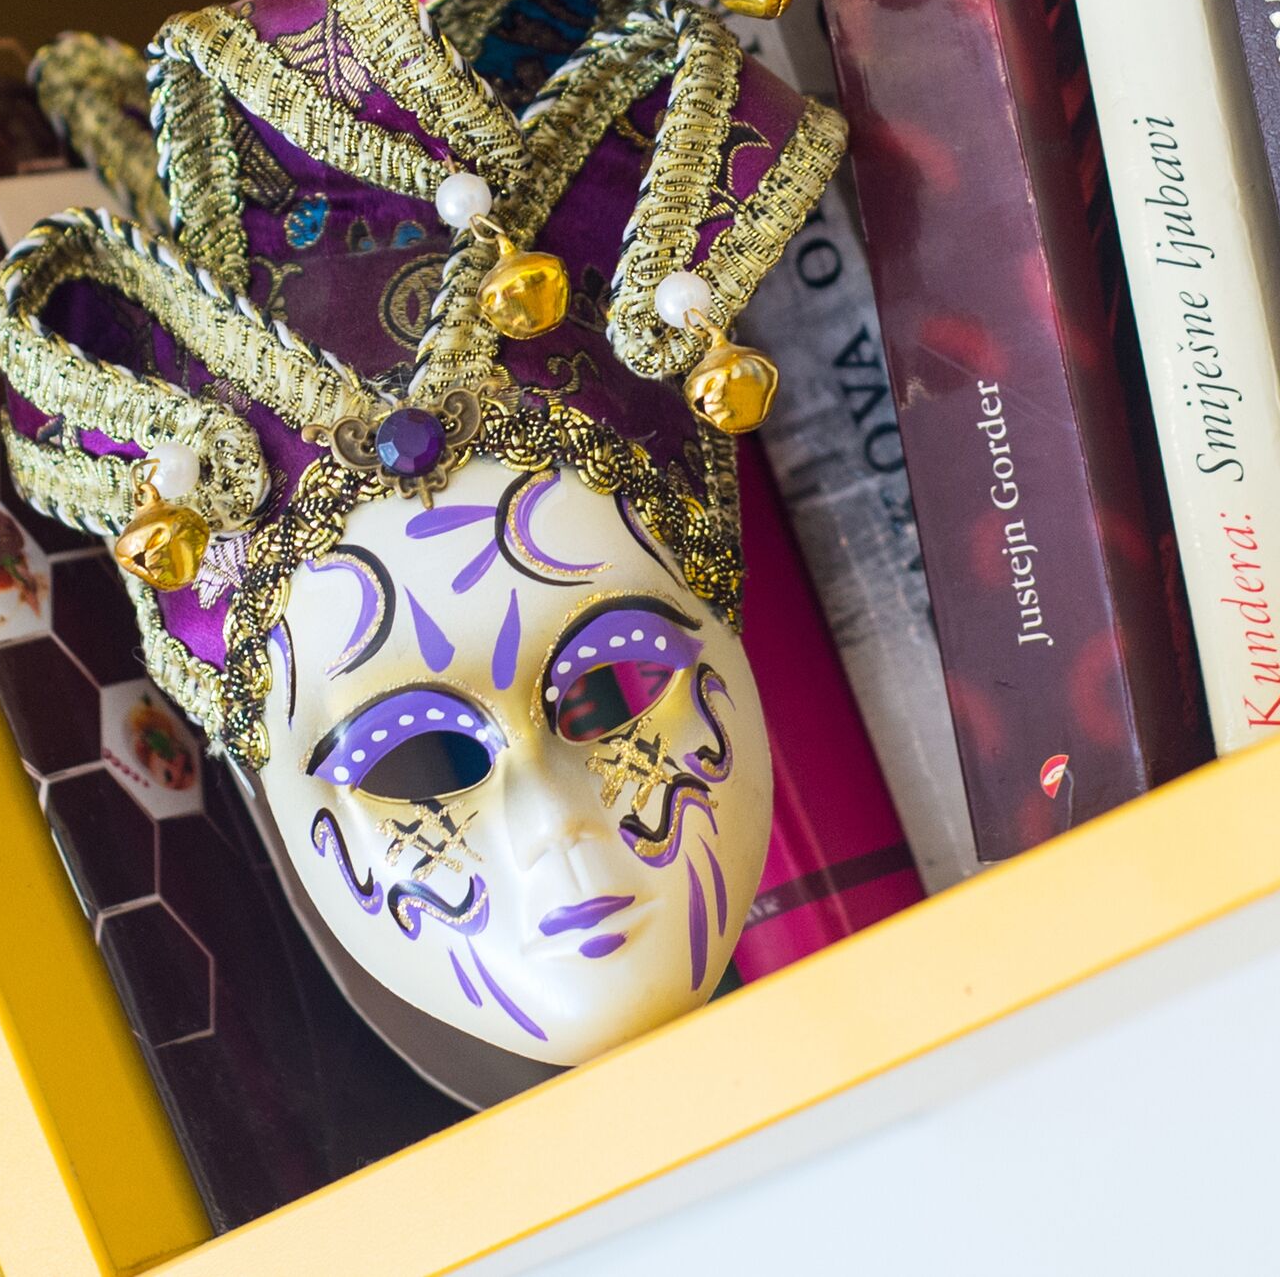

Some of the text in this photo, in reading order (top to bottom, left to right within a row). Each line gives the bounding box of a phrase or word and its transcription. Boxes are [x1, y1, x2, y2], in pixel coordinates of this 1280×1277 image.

[1133, 114, 1216, 271] ljubavi
[1179, 288, 1245, 483] Smiješne
[978, 378, 1055, 647] Justejn Gorder
